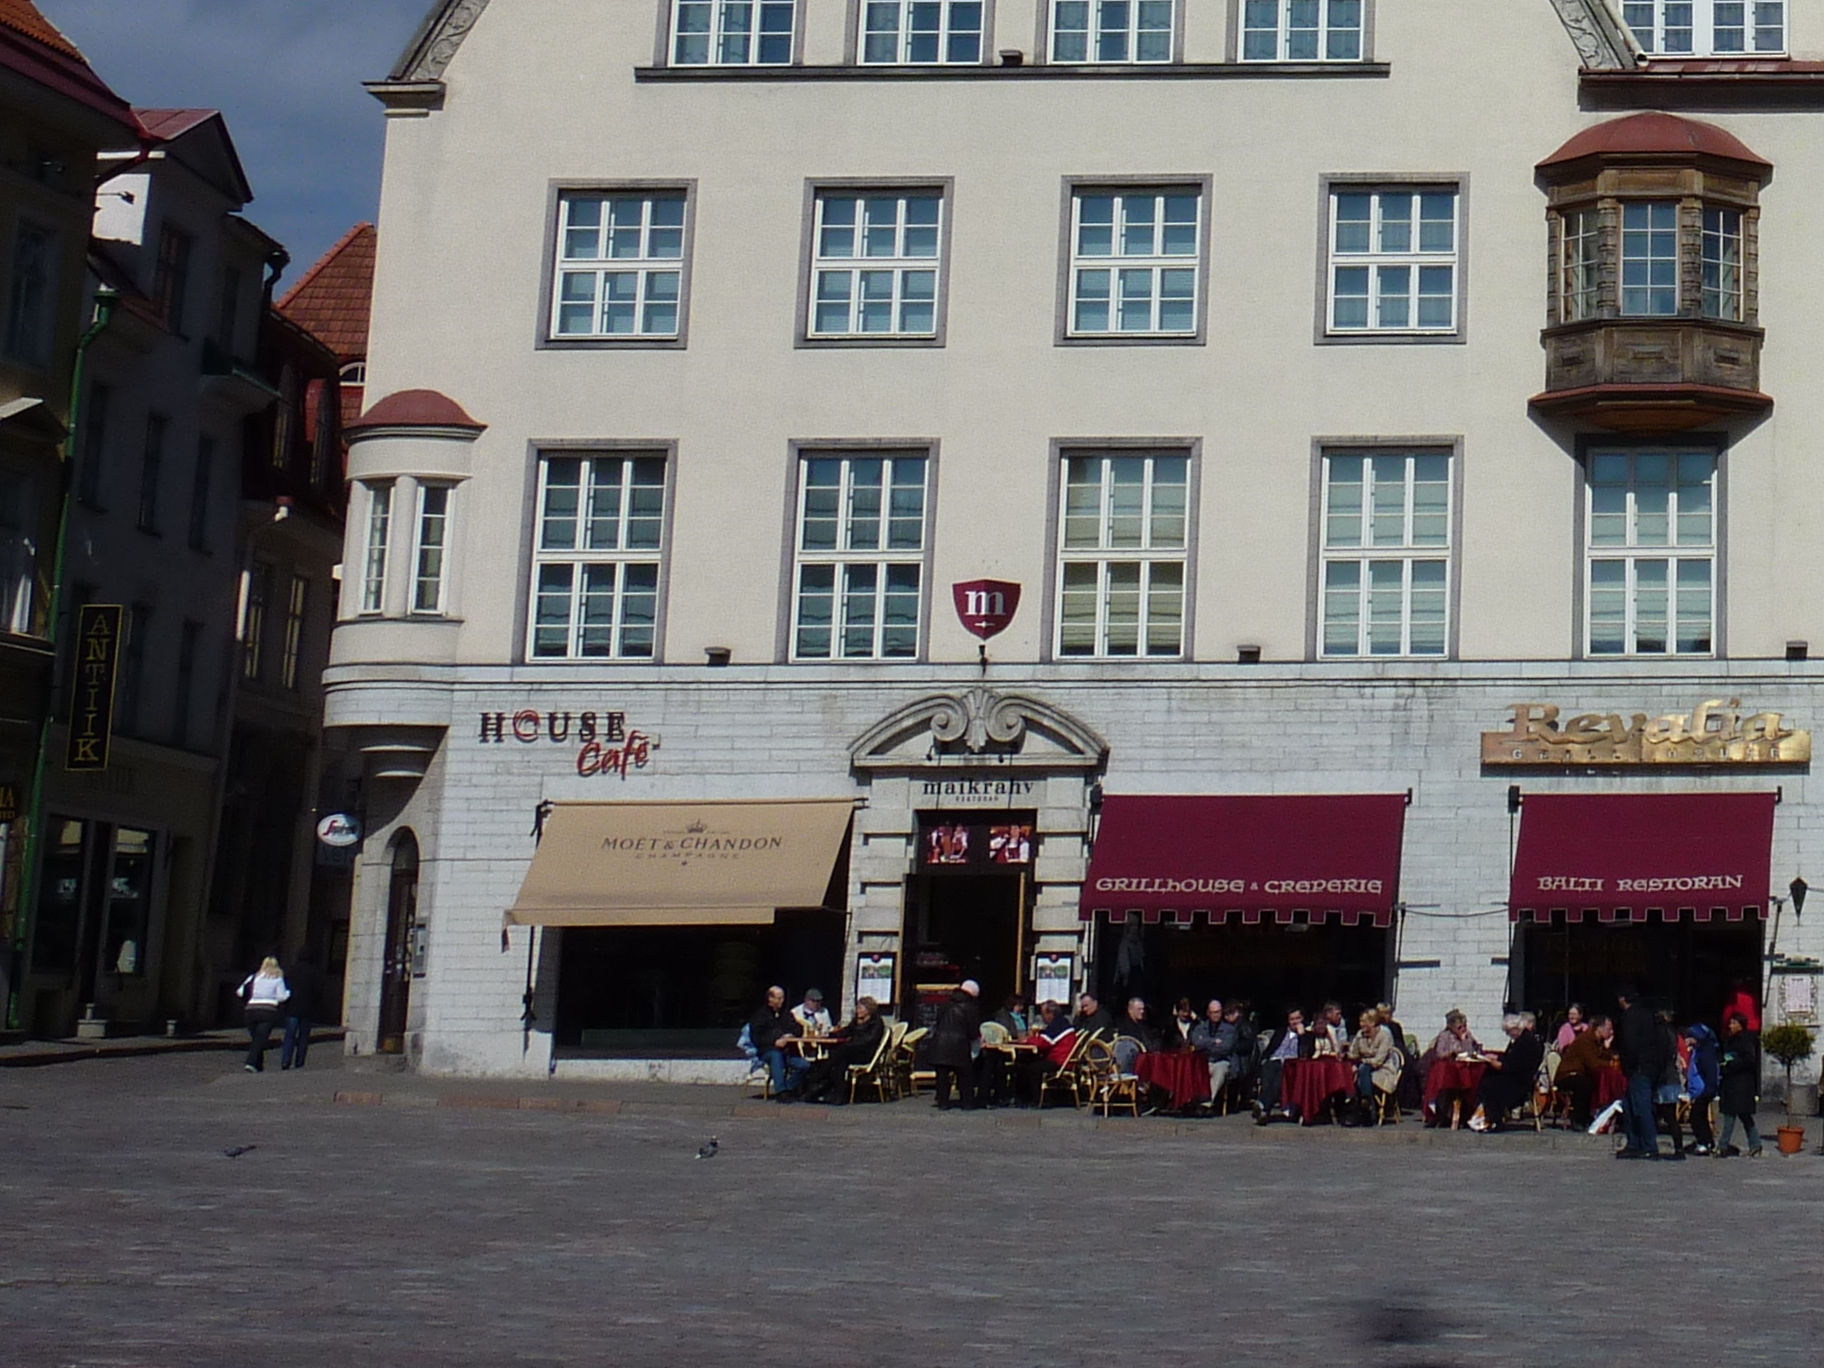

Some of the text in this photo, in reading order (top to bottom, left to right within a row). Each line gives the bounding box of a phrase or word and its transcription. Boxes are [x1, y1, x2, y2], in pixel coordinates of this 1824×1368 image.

[965, 590, 1006, 616] m
[73, 613, 111, 763] ANTIIK
[479, 709, 625, 744] HOUSE
[1505, 697, 1794, 745] Revalia
[663, 839, 674, 851] &
[680, 836, 783, 851] CHANDON
[1264, 879, 1383, 894] CREPERIE
[1537, 874, 1744, 892] BALTI RESTORAN
